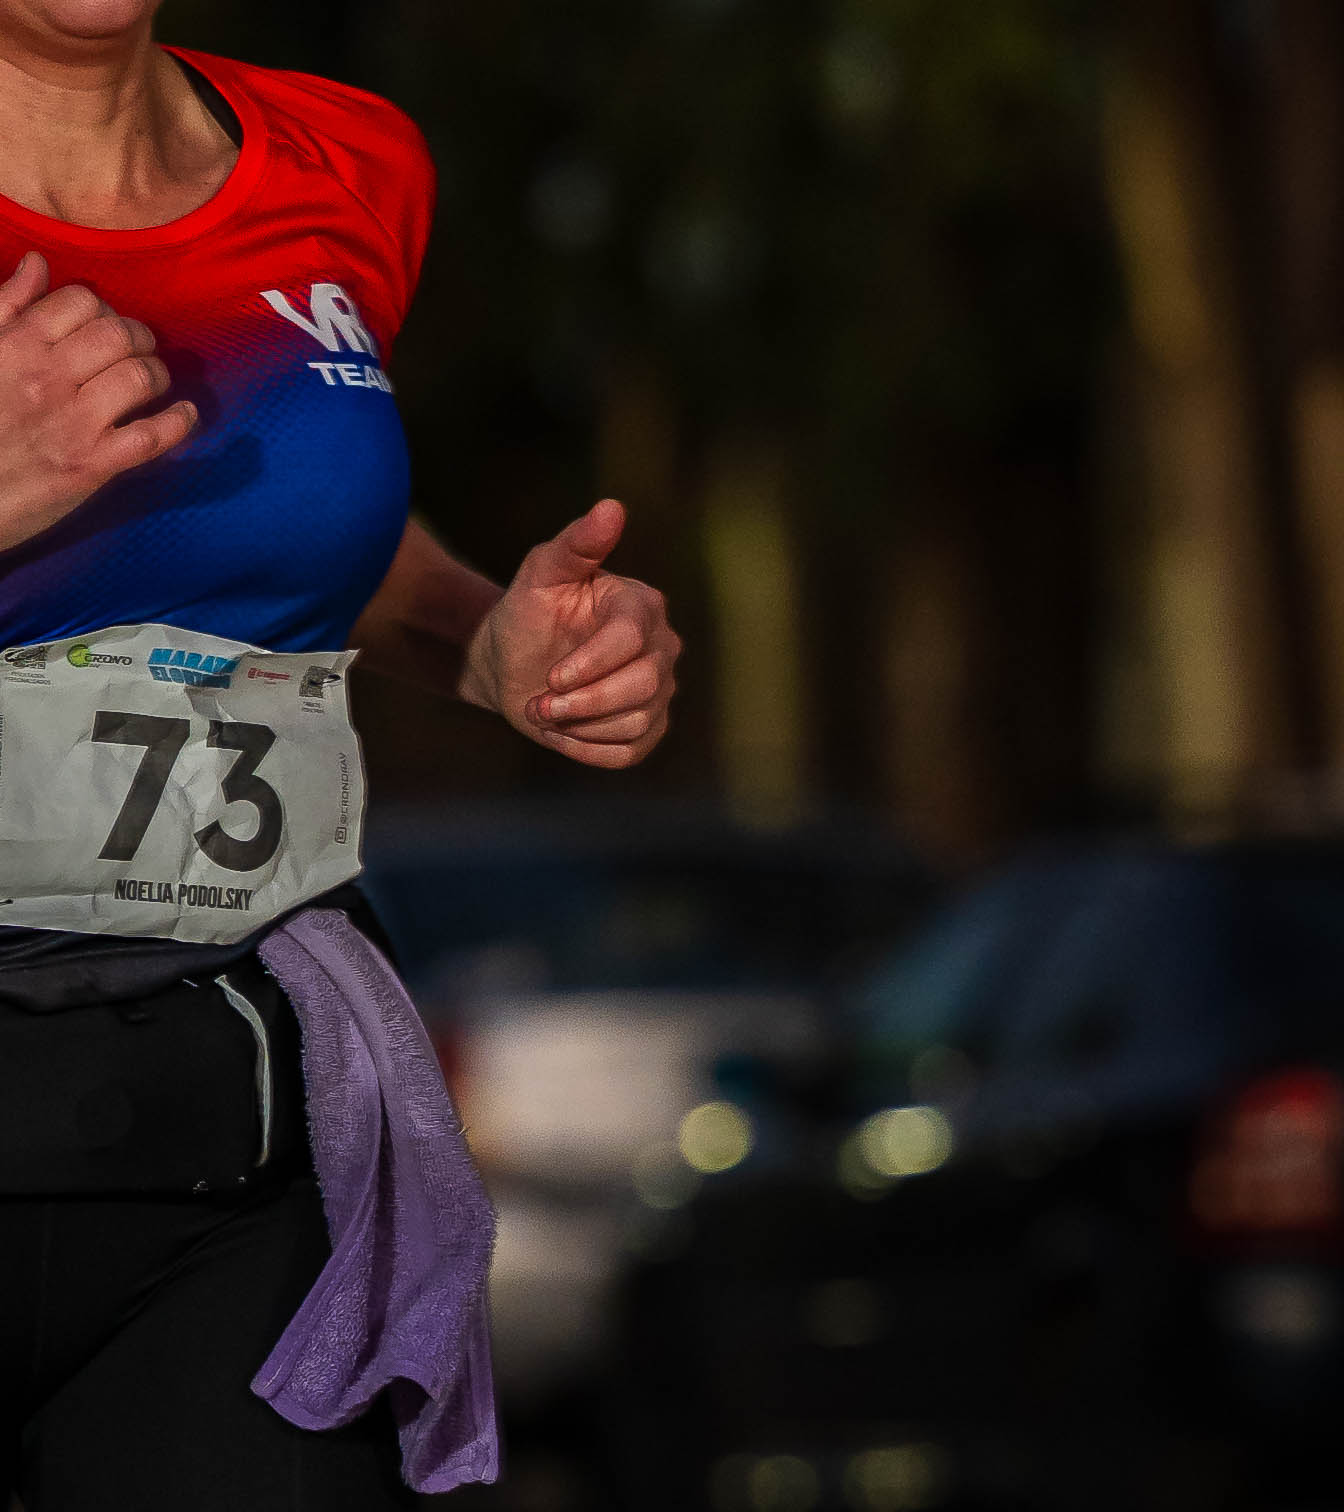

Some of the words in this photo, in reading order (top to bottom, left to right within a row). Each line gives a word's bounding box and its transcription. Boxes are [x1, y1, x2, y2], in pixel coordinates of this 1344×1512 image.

[91, 710, 283, 873] 73
[114, 879, 174, 904] NOELIA
[177, 883, 253, 911] PODOLSKY
